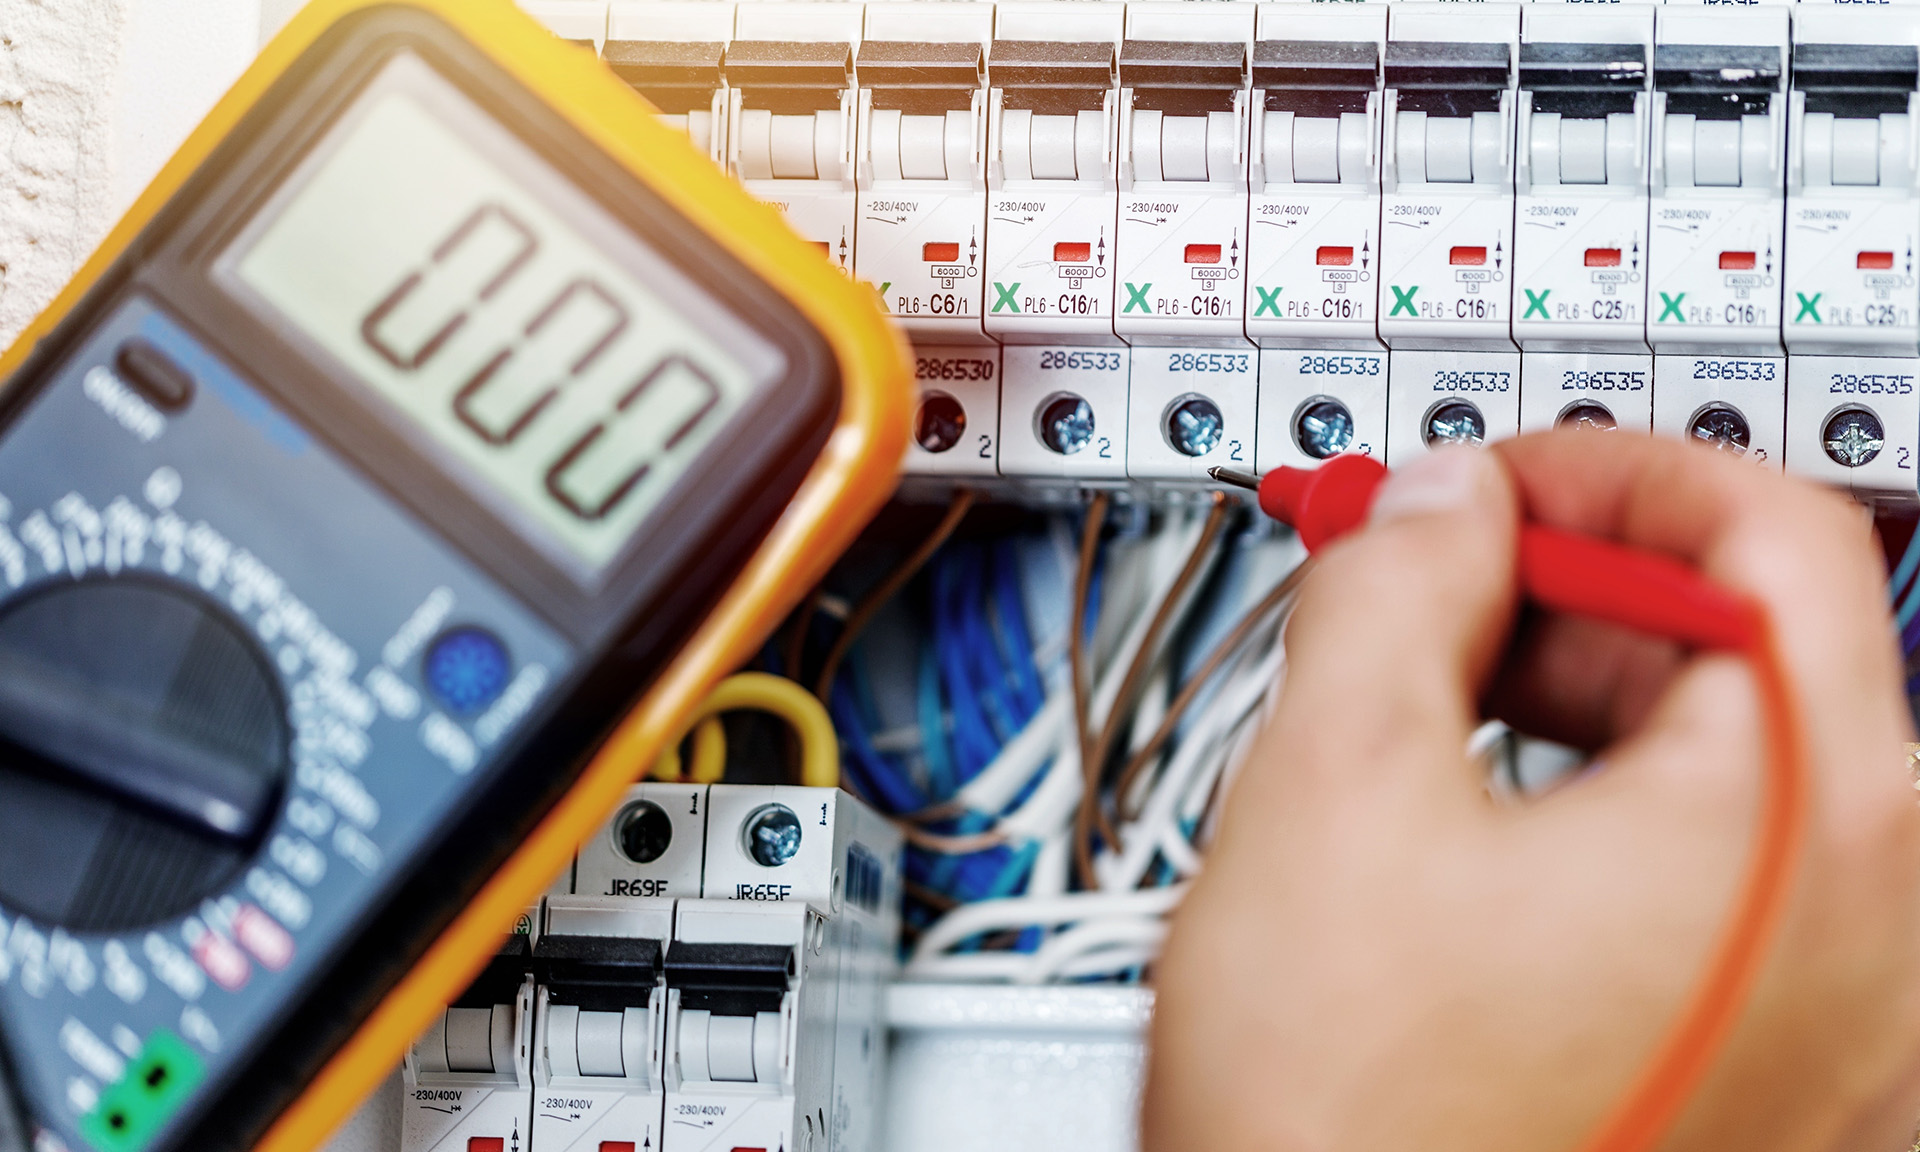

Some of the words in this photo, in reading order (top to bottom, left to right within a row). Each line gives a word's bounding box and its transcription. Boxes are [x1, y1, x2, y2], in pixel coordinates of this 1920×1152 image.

[937, 268, 960, 276] 6000
[1065, 268, 1089, 276] 6000
[1197, 269, 1222, 278] 6000
[1328, 272, 1353, 280] 6000
[1461, 272, 1486, 280] 6000
[915, 358, 994, 380] 286530
[1040, 351, 1120, 370] 286533
[1169, 354, 1248, 373] 286533
[1300, 356, 1380, 375] 286533
[1694, 361, 1775, 381] 286533
[1433, 371, 1511, 392] 286533
[1562, 371, 1645, 391] 286535
[1830, 374, 1913, 394] 286535
[979, 435, 991, 458] 2
[1098, 438, 1111, 458] 2
[1229, 440, 1243, 461] 2
[1897, 447, 1910, 469] 2
[604, 879, 668, 897] JR69F
[728, 884, 792, 901] JR65F
